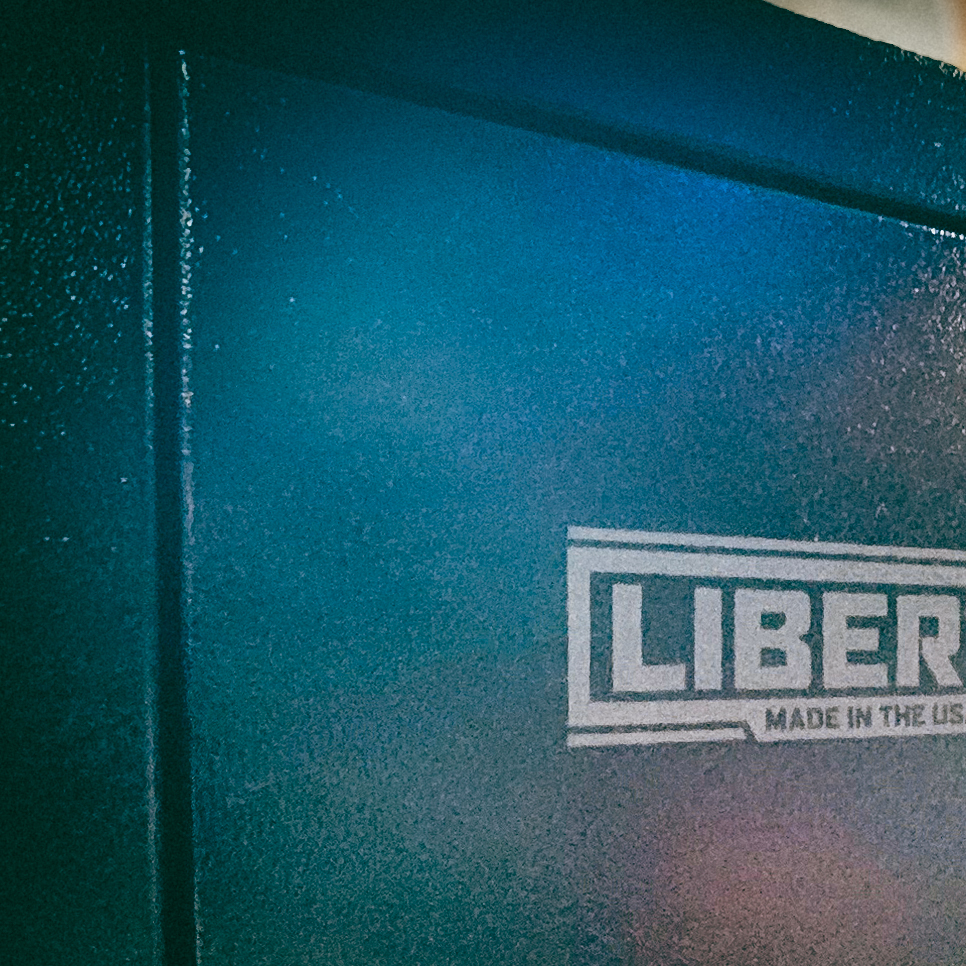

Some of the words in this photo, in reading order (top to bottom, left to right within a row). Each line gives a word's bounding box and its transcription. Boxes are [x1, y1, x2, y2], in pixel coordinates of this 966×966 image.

[765, 708, 839, 732] MADE
[847, 707, 873, 730] IN
[879, 705, 926, 727] THE
